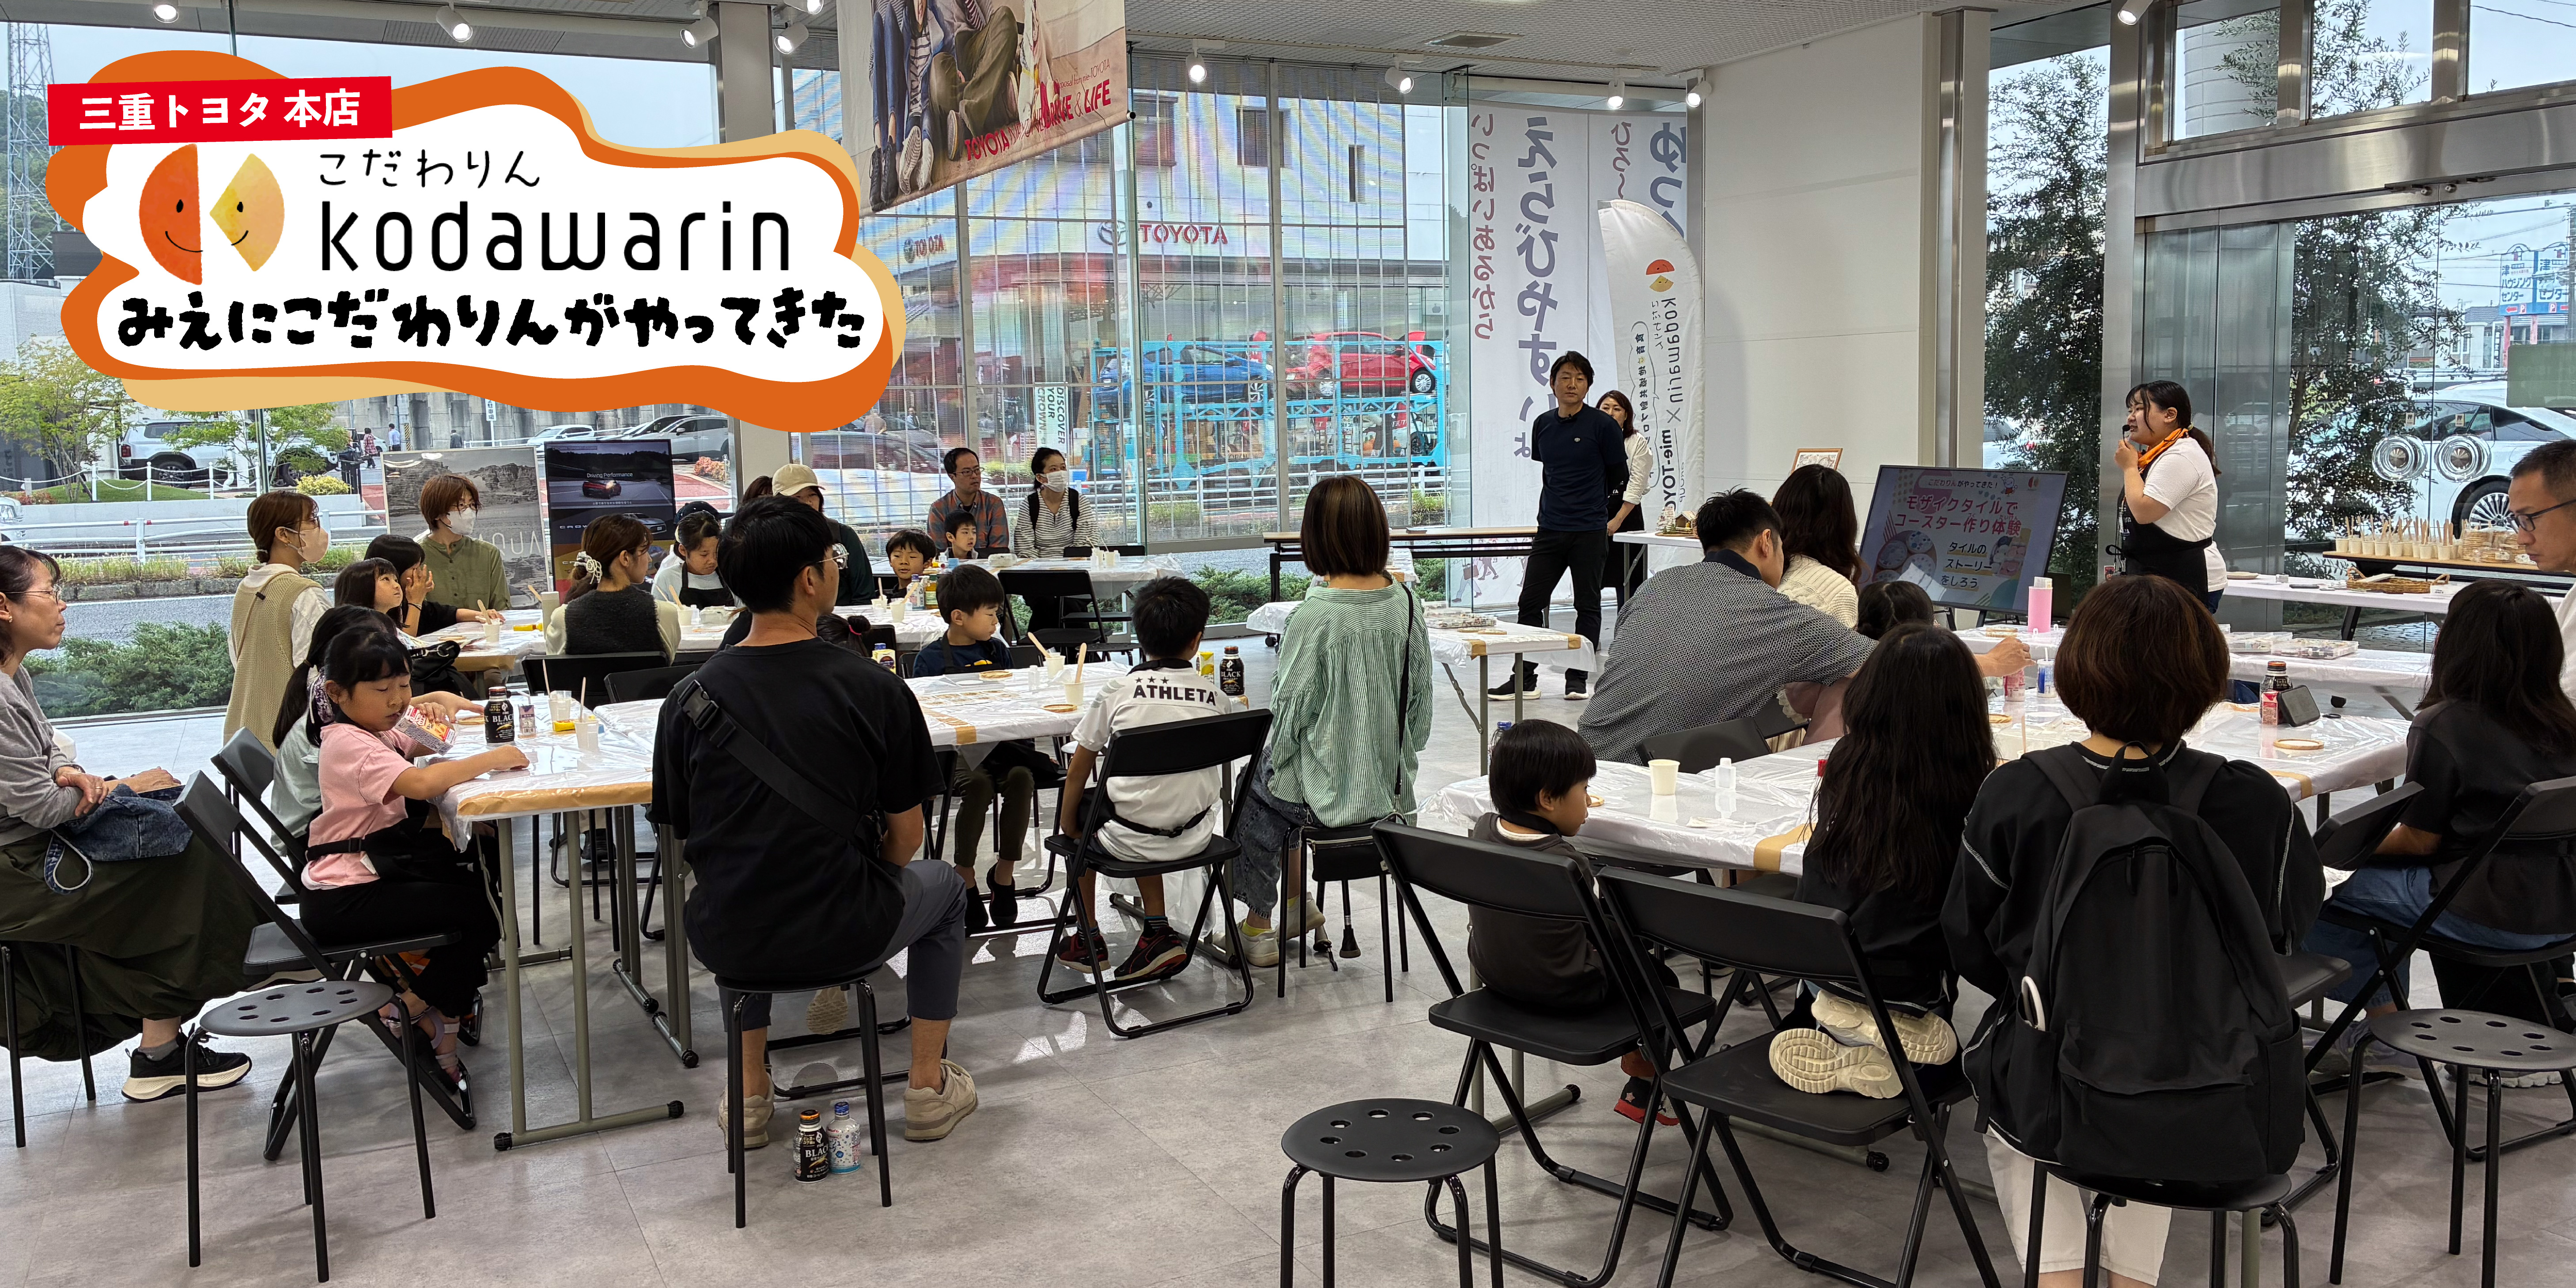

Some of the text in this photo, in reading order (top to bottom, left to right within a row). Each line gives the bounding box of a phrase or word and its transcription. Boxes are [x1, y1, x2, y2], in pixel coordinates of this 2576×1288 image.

[965, 128, 1010, 161] TOYOTA
[1085, 79, 1111, 113] LIFE
[1139, 224, 1228, 244] TOYOTA
[2502, 264, 2510, 276] 津
[2540, 259, 2550, 271] 津
[2501, 277, 2531, 289] ハウジング
[2501, 291, 2524, 302] センター
[1907, 495, 2018, 515] モザイクタイルで
[1895, 514, 2022, 536] コースター作り体験
[479, 530, 541, 556] QUA
[1949, 542, 1986, 555] タイルの
[1945, 559, 1992, 571] ストーリー
[1941, 576, 1978, 589] をしろう
[1133, 685, 1216, 706] ATHLETA
[806, 1145, 828, 1157] BLAC
